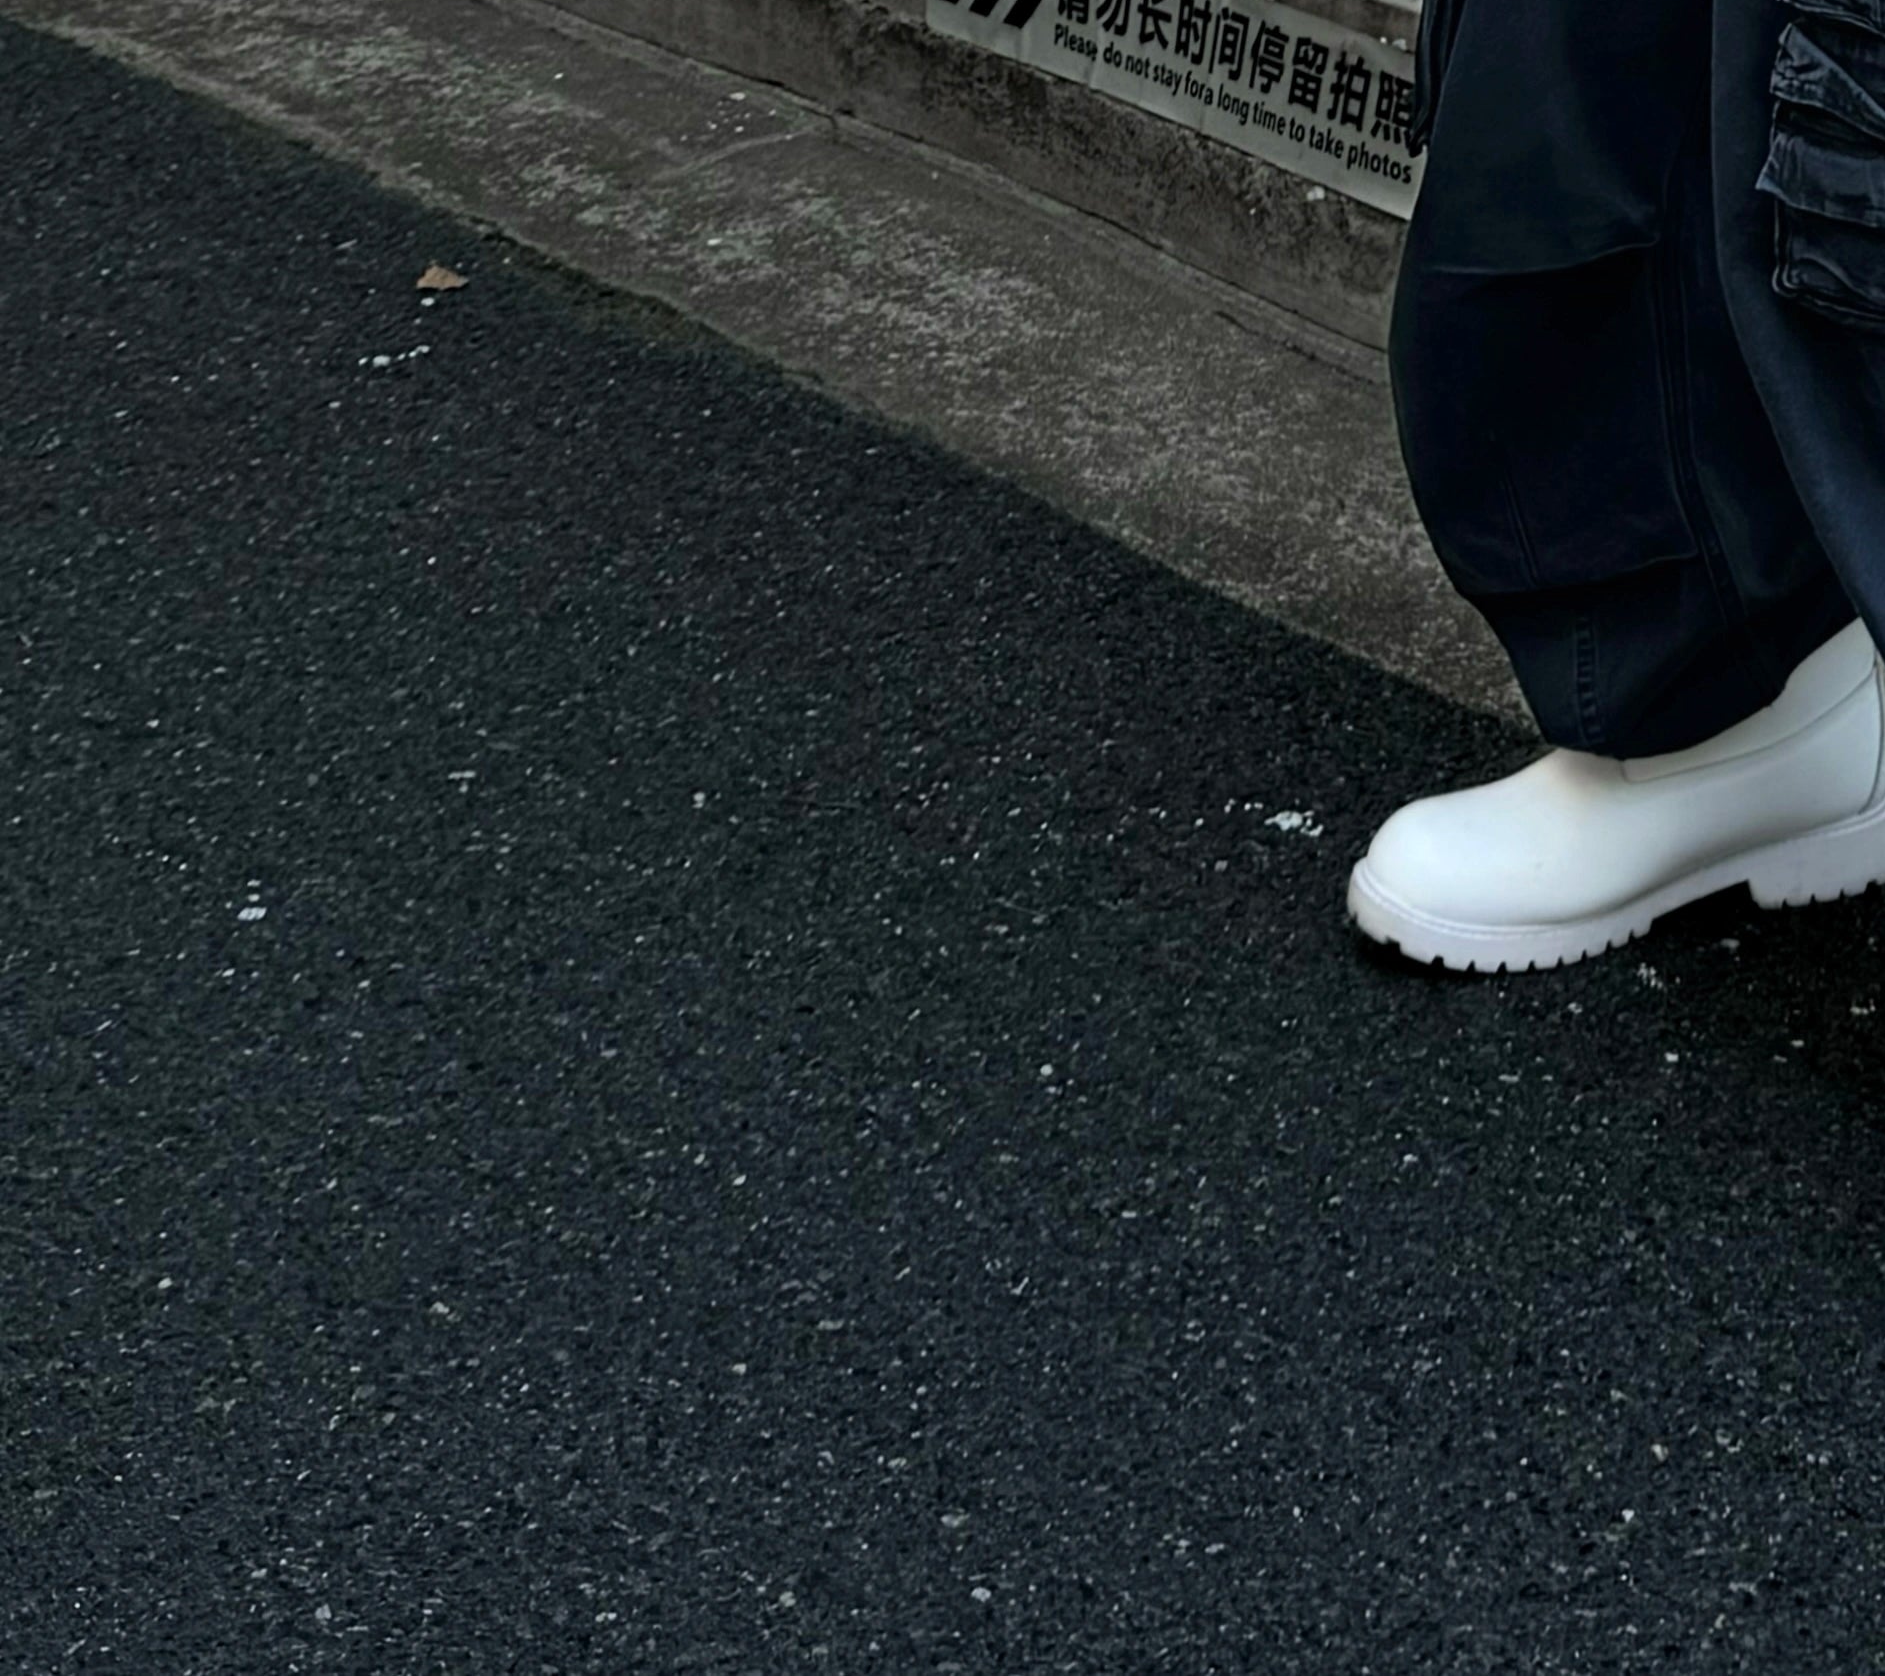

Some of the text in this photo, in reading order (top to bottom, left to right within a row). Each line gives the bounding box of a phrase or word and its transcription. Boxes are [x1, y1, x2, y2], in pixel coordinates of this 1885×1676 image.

[1103, 41, 1122, 69] do
[1125, 54, 1150, 79] not
[1153, 64, 1183, 96] stay
[1204, 88, 1214, 106] a
[1217, 83, 1250, 126] long
[1253, 101, 1286, 136] time
[1289, 117, 1305, 143] to
[1309, 125, 1344, 159] take
[1347, 141, 1412, 185] photos
